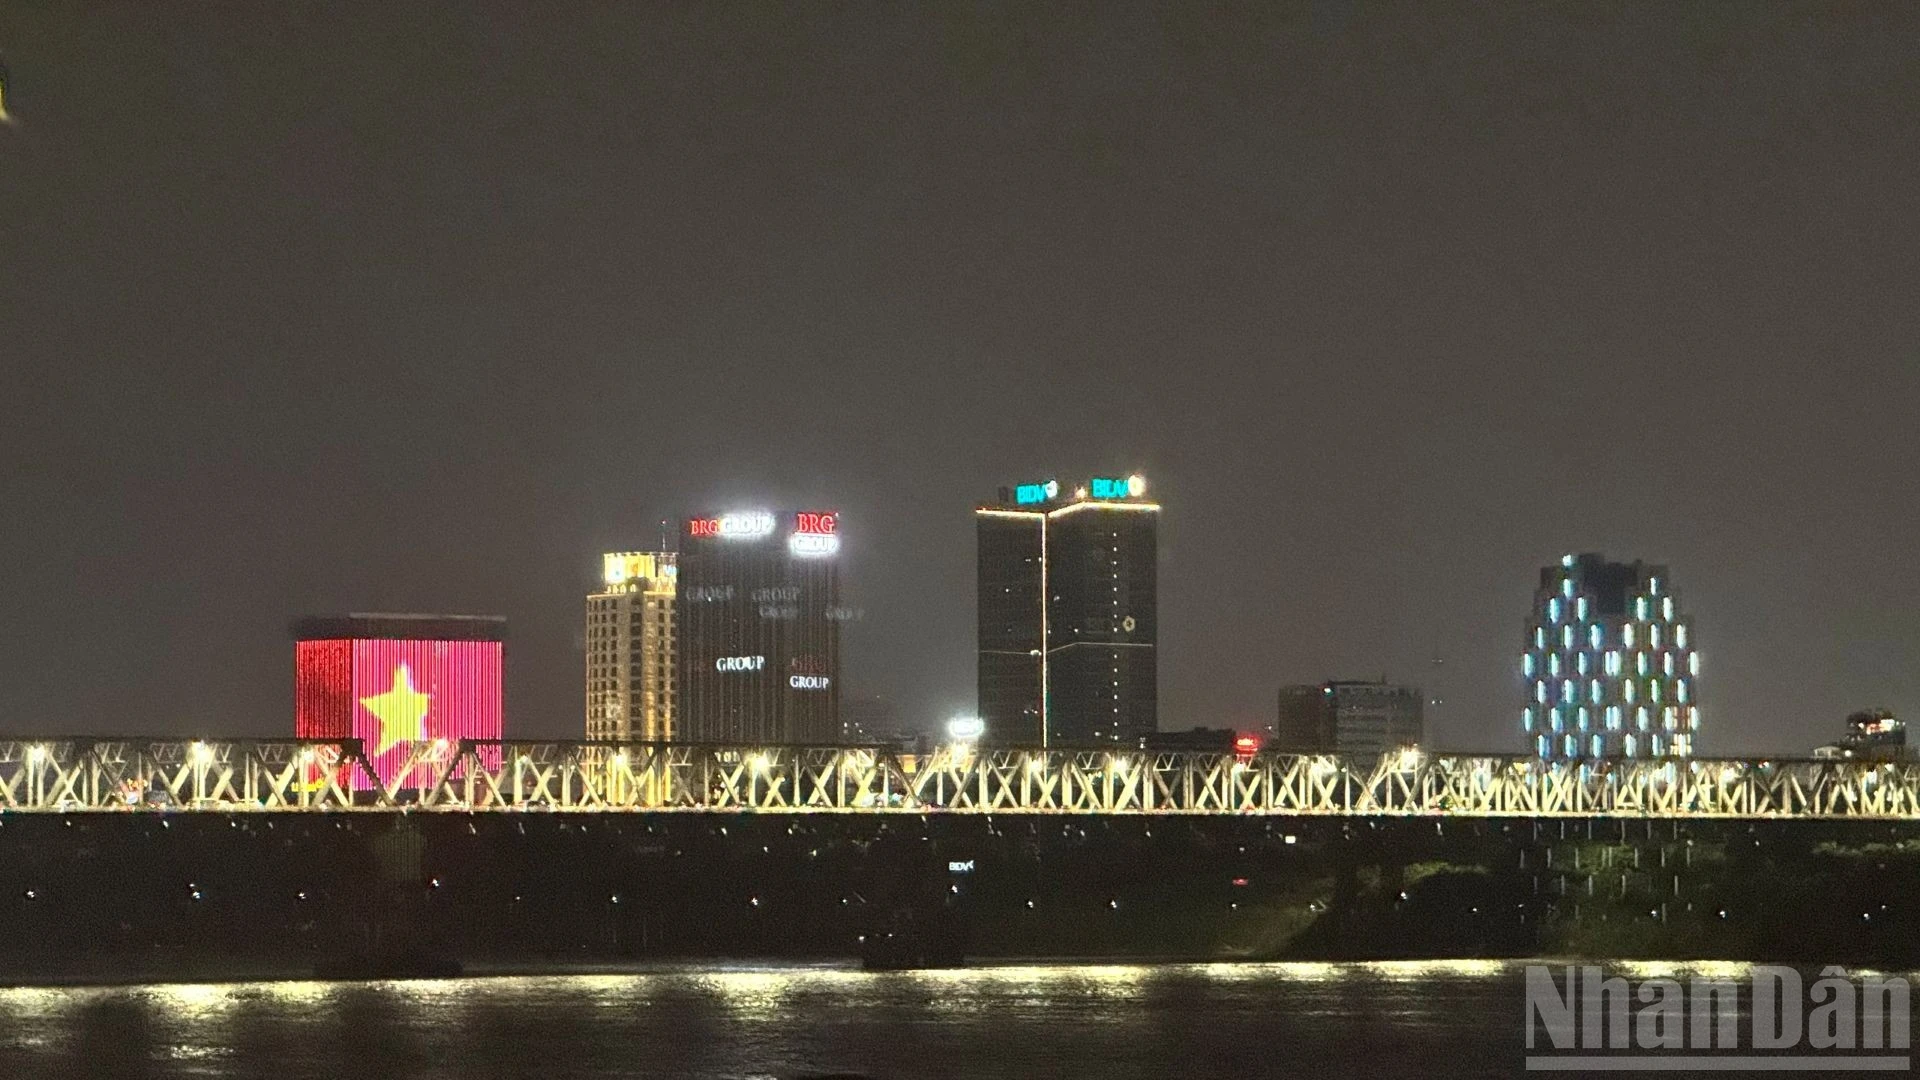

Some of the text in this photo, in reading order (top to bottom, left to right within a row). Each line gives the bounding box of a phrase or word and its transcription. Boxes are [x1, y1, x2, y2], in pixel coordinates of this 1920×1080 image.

[1016, 484, 1047, 504] BIDV
[1092, 477, 1129, 498] BIDV
[691, 515, 773, 535] BRG GROUP
[797, 513, 835, 533] BRG
[716, 655, 764, 672] GROUP
[789, 675, 830, 690] GROUP
